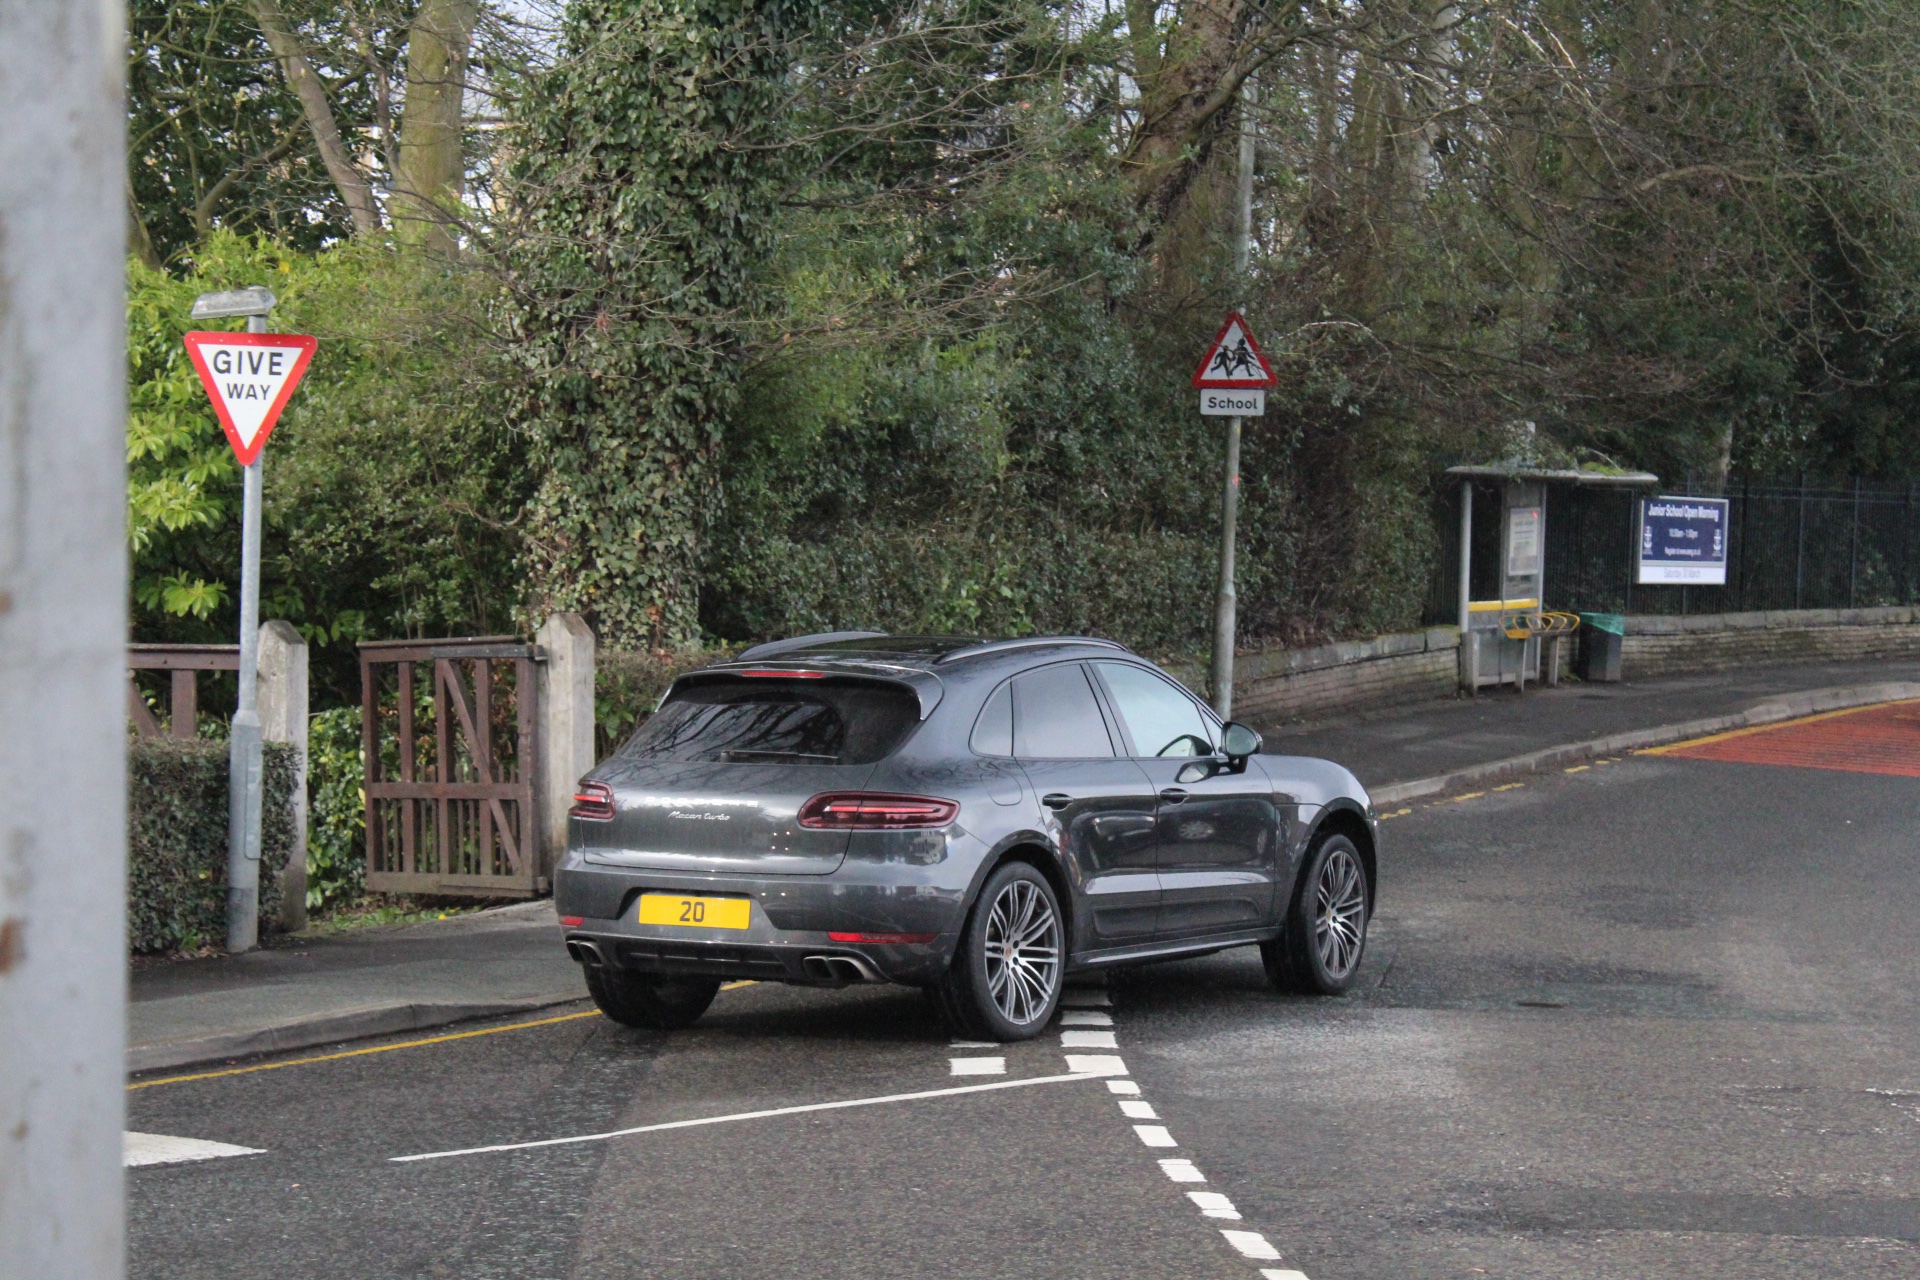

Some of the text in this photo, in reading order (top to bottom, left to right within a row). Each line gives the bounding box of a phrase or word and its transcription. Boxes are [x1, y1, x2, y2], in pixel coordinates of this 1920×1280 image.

[213, 350, 283, 376] GIVE
[226, 382, 271, 400] WAY
[1207, 396, 1258, 409] School
[1648, 503, 1666, 516] Junior
[1666, 504, 1684, 517] School
[1684, 505, 1698, 520] Open
[679, 901, 705, 923] 20
